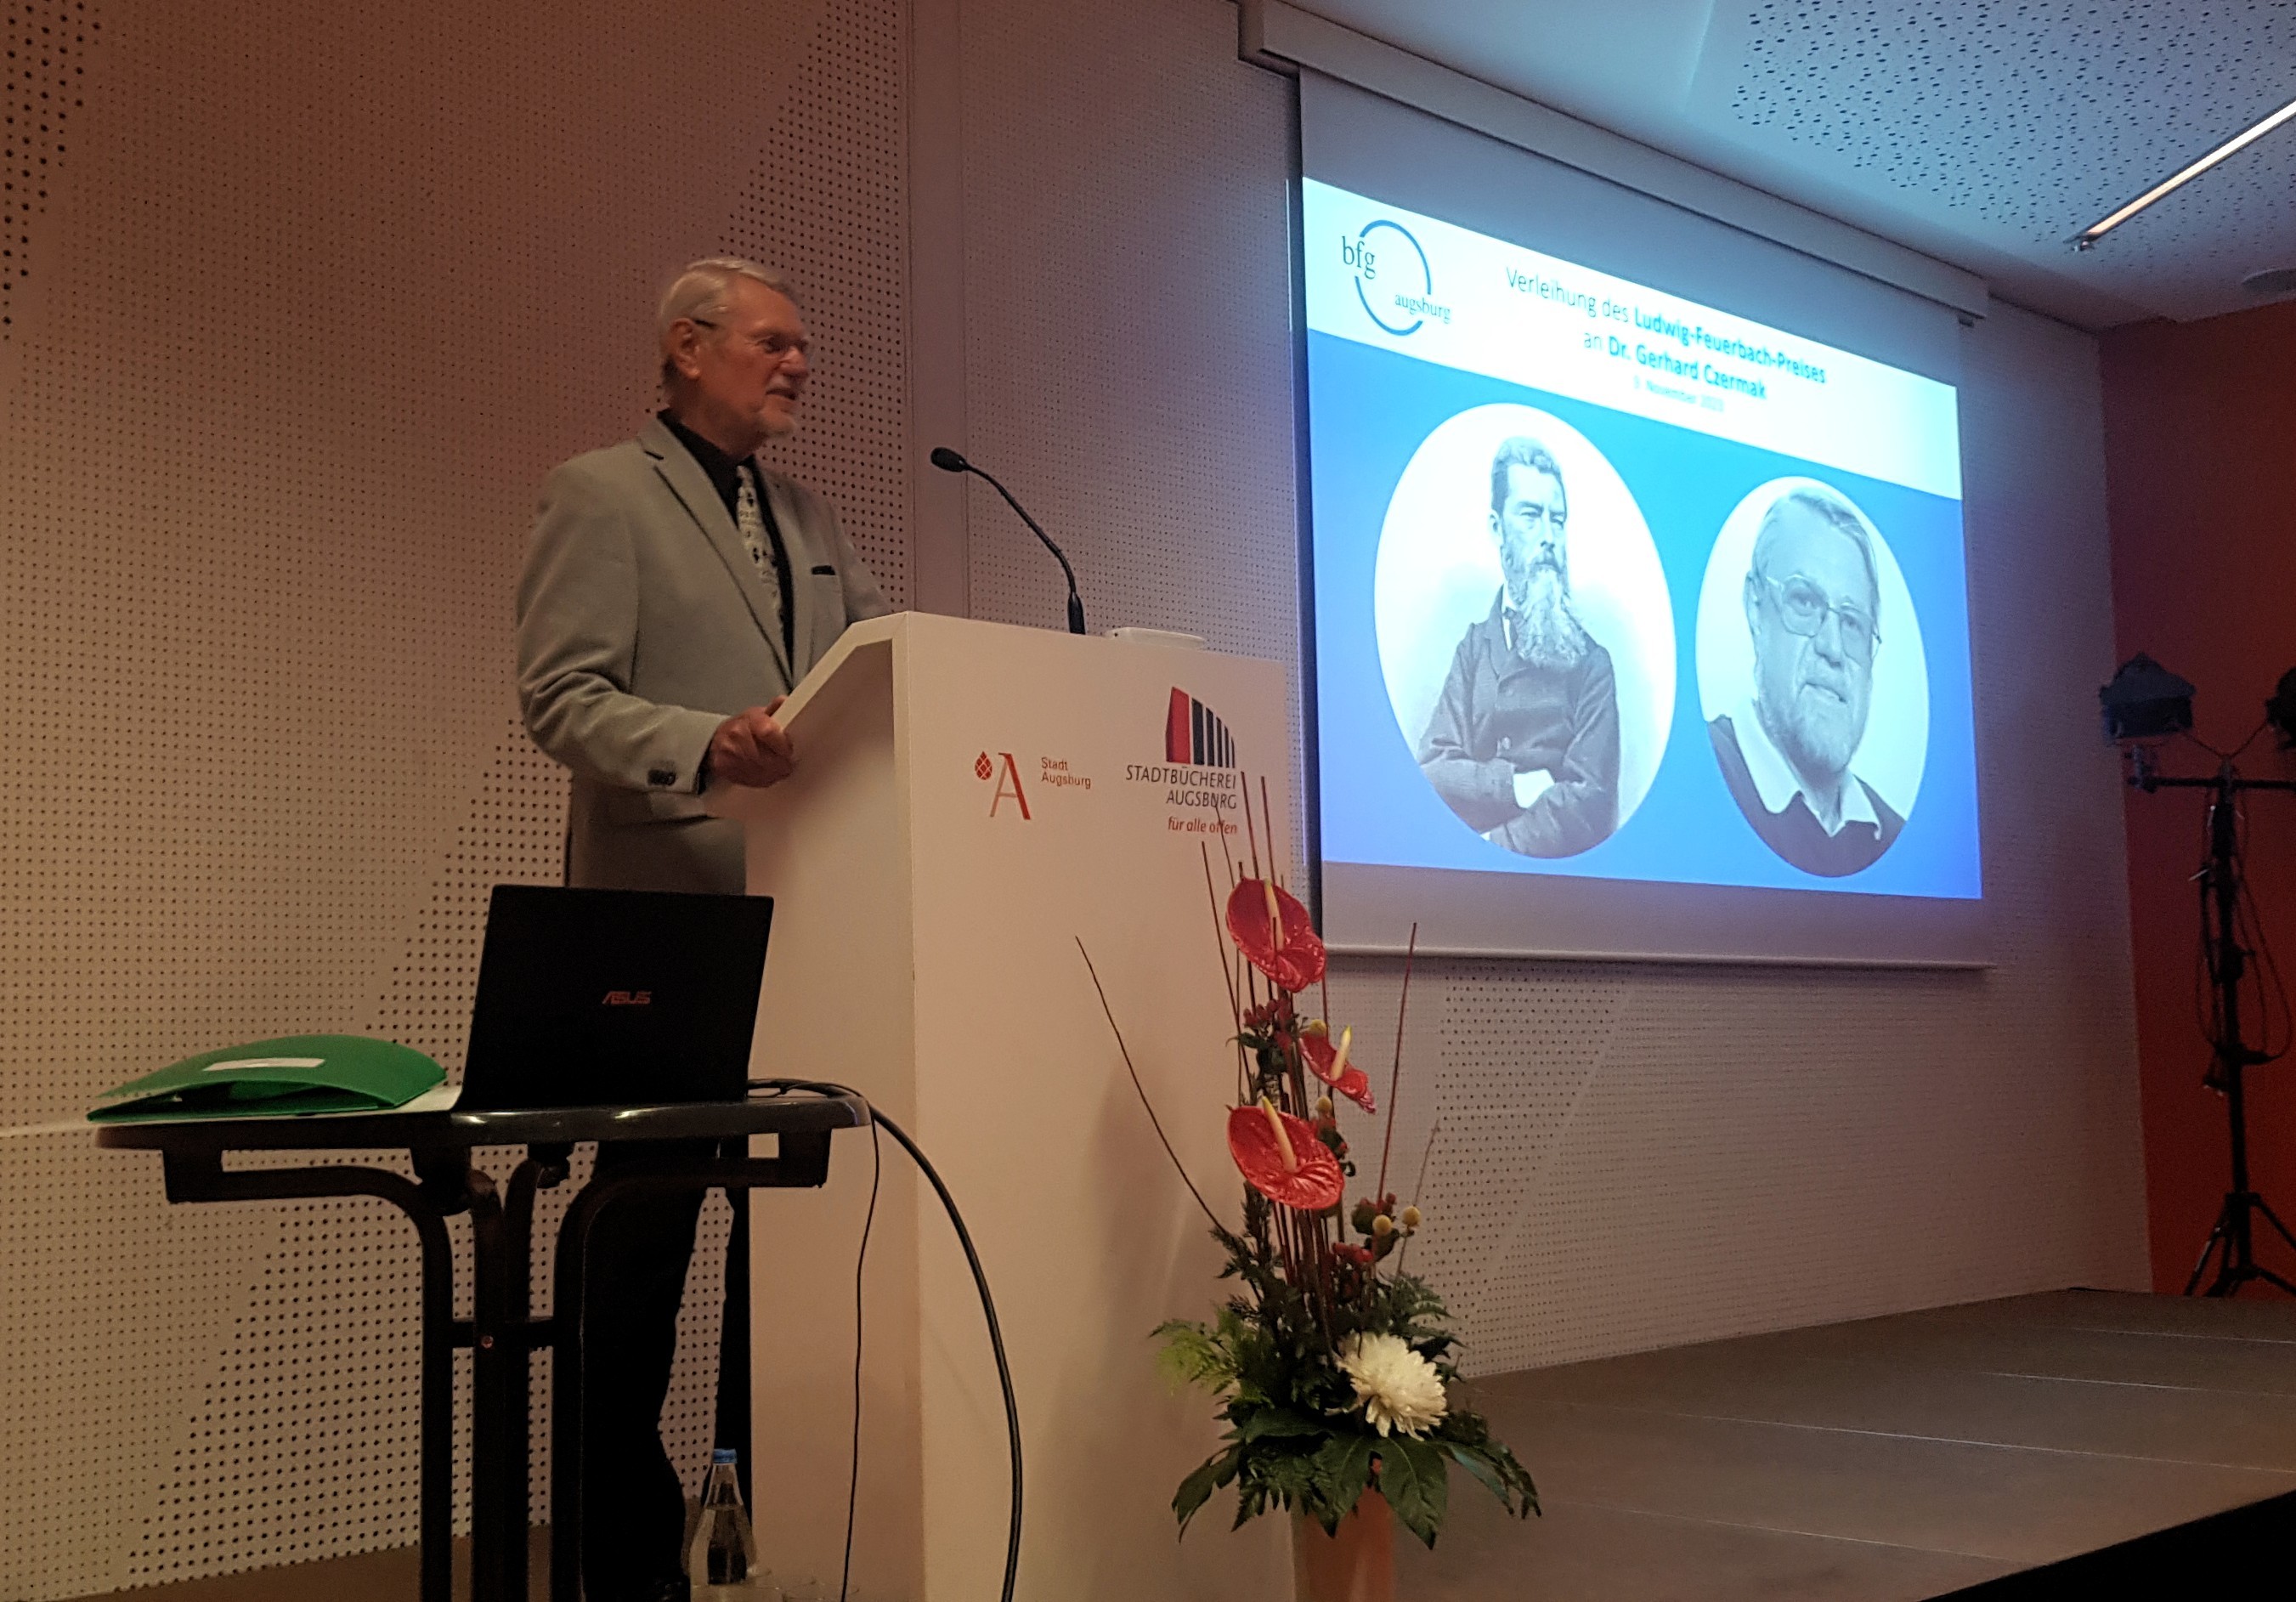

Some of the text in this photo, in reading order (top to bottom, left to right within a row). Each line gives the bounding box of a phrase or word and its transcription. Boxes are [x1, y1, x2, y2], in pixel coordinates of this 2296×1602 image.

[1341, 235, 1376, 280] bfg
[1394, 294, 1451, 325] augsburg
[1506, 266, 1826, 384] Verleihung des Ludwig-Feuerbach-Preises
[1584, 332, 1767, 399] an Dr. Gerhard Czermak
[1041, 756, 1068, 771] Stadt
[1041, 772, 1091, 790] Augsburg
[1126, 765, 1236, 790] STADTBÜCHEREI
[1166, 790, 1237, 810] AUGSBURG
[1168, 816, 1185, 832] für
[1186, 818, 1207, 833] alle
[602, 990, 652, 1005] ASUS
